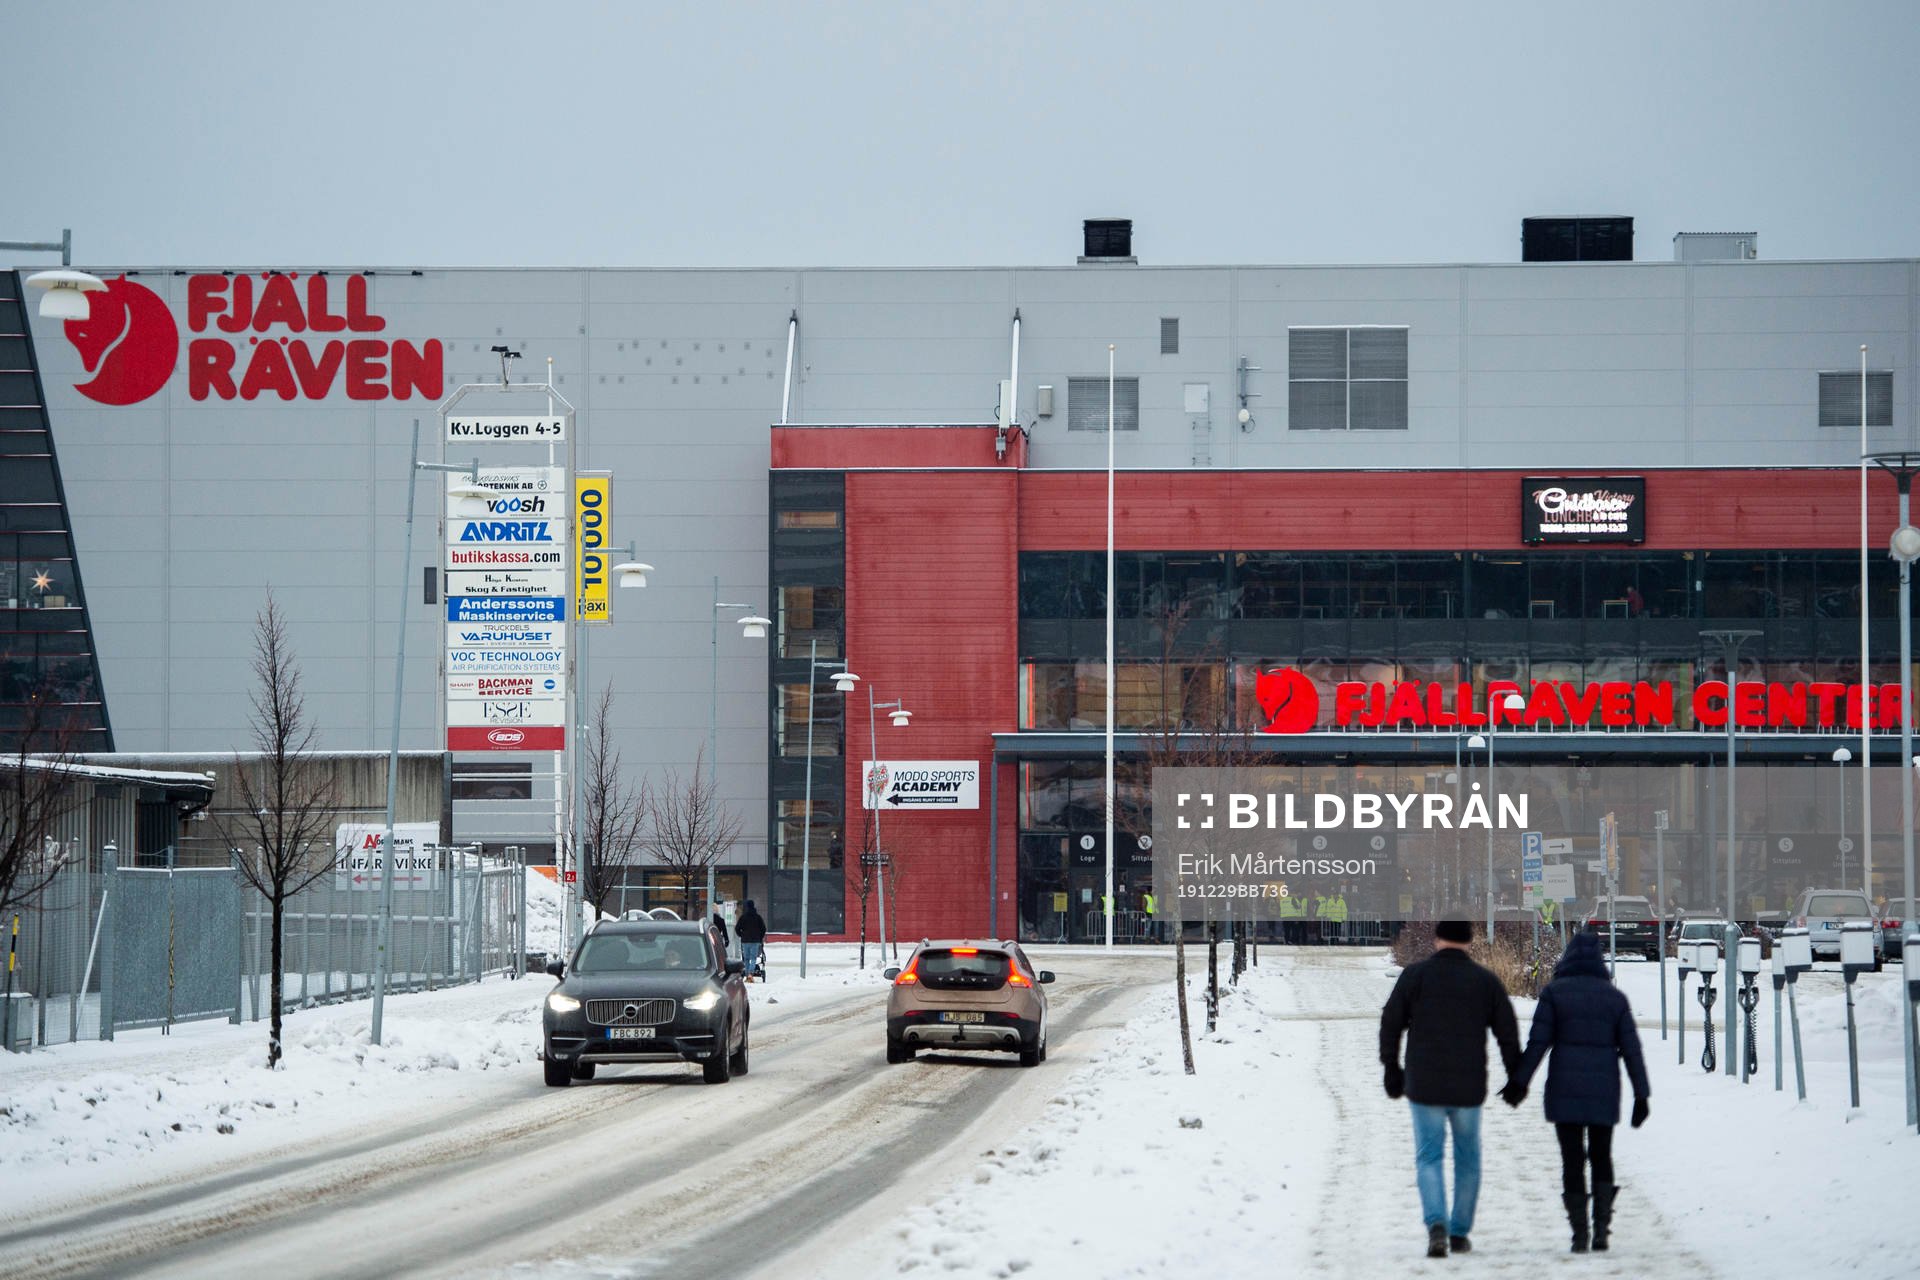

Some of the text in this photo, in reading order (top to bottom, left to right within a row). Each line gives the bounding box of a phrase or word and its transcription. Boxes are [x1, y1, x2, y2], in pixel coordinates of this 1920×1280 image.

[187, 271, 386, 333] FJÄLL
[188, 336, 444, 401] RÄVEN
[535, 422, 561, 435] 4-5
[521, 482, 534, 490] AB
[487, 495, 545, 514] voosh
[451, 550, 561, 564] butikskassa.com
[465, 586, 489, 594] Skog
[500, 585, 548, 594] Fastighet
[459, 598, 555, 610] Anderssons
[458, 611, 555, 621] Maskinservice
[460, 632, 553, 641] VARUHUSET
[451, 651, 562, 662] VOC TECHNOLOGY
[451, 663, 561, 672] AIR PURIFICATION SYSTEMS
[478, 678, 533, 689] BACKMAN
[478, 687, 533, 695] SERVICE
[1335, 678, 1918, 729] FJÄLLRÄVEN CENTER
[893, 770, 976, 782] MODO SPORTS
[891, 781, 962, 792] ACADEMY
[1772, 857, 1801, 865] Sittplats
[613, 1029, 652, 1037] FBC 892
